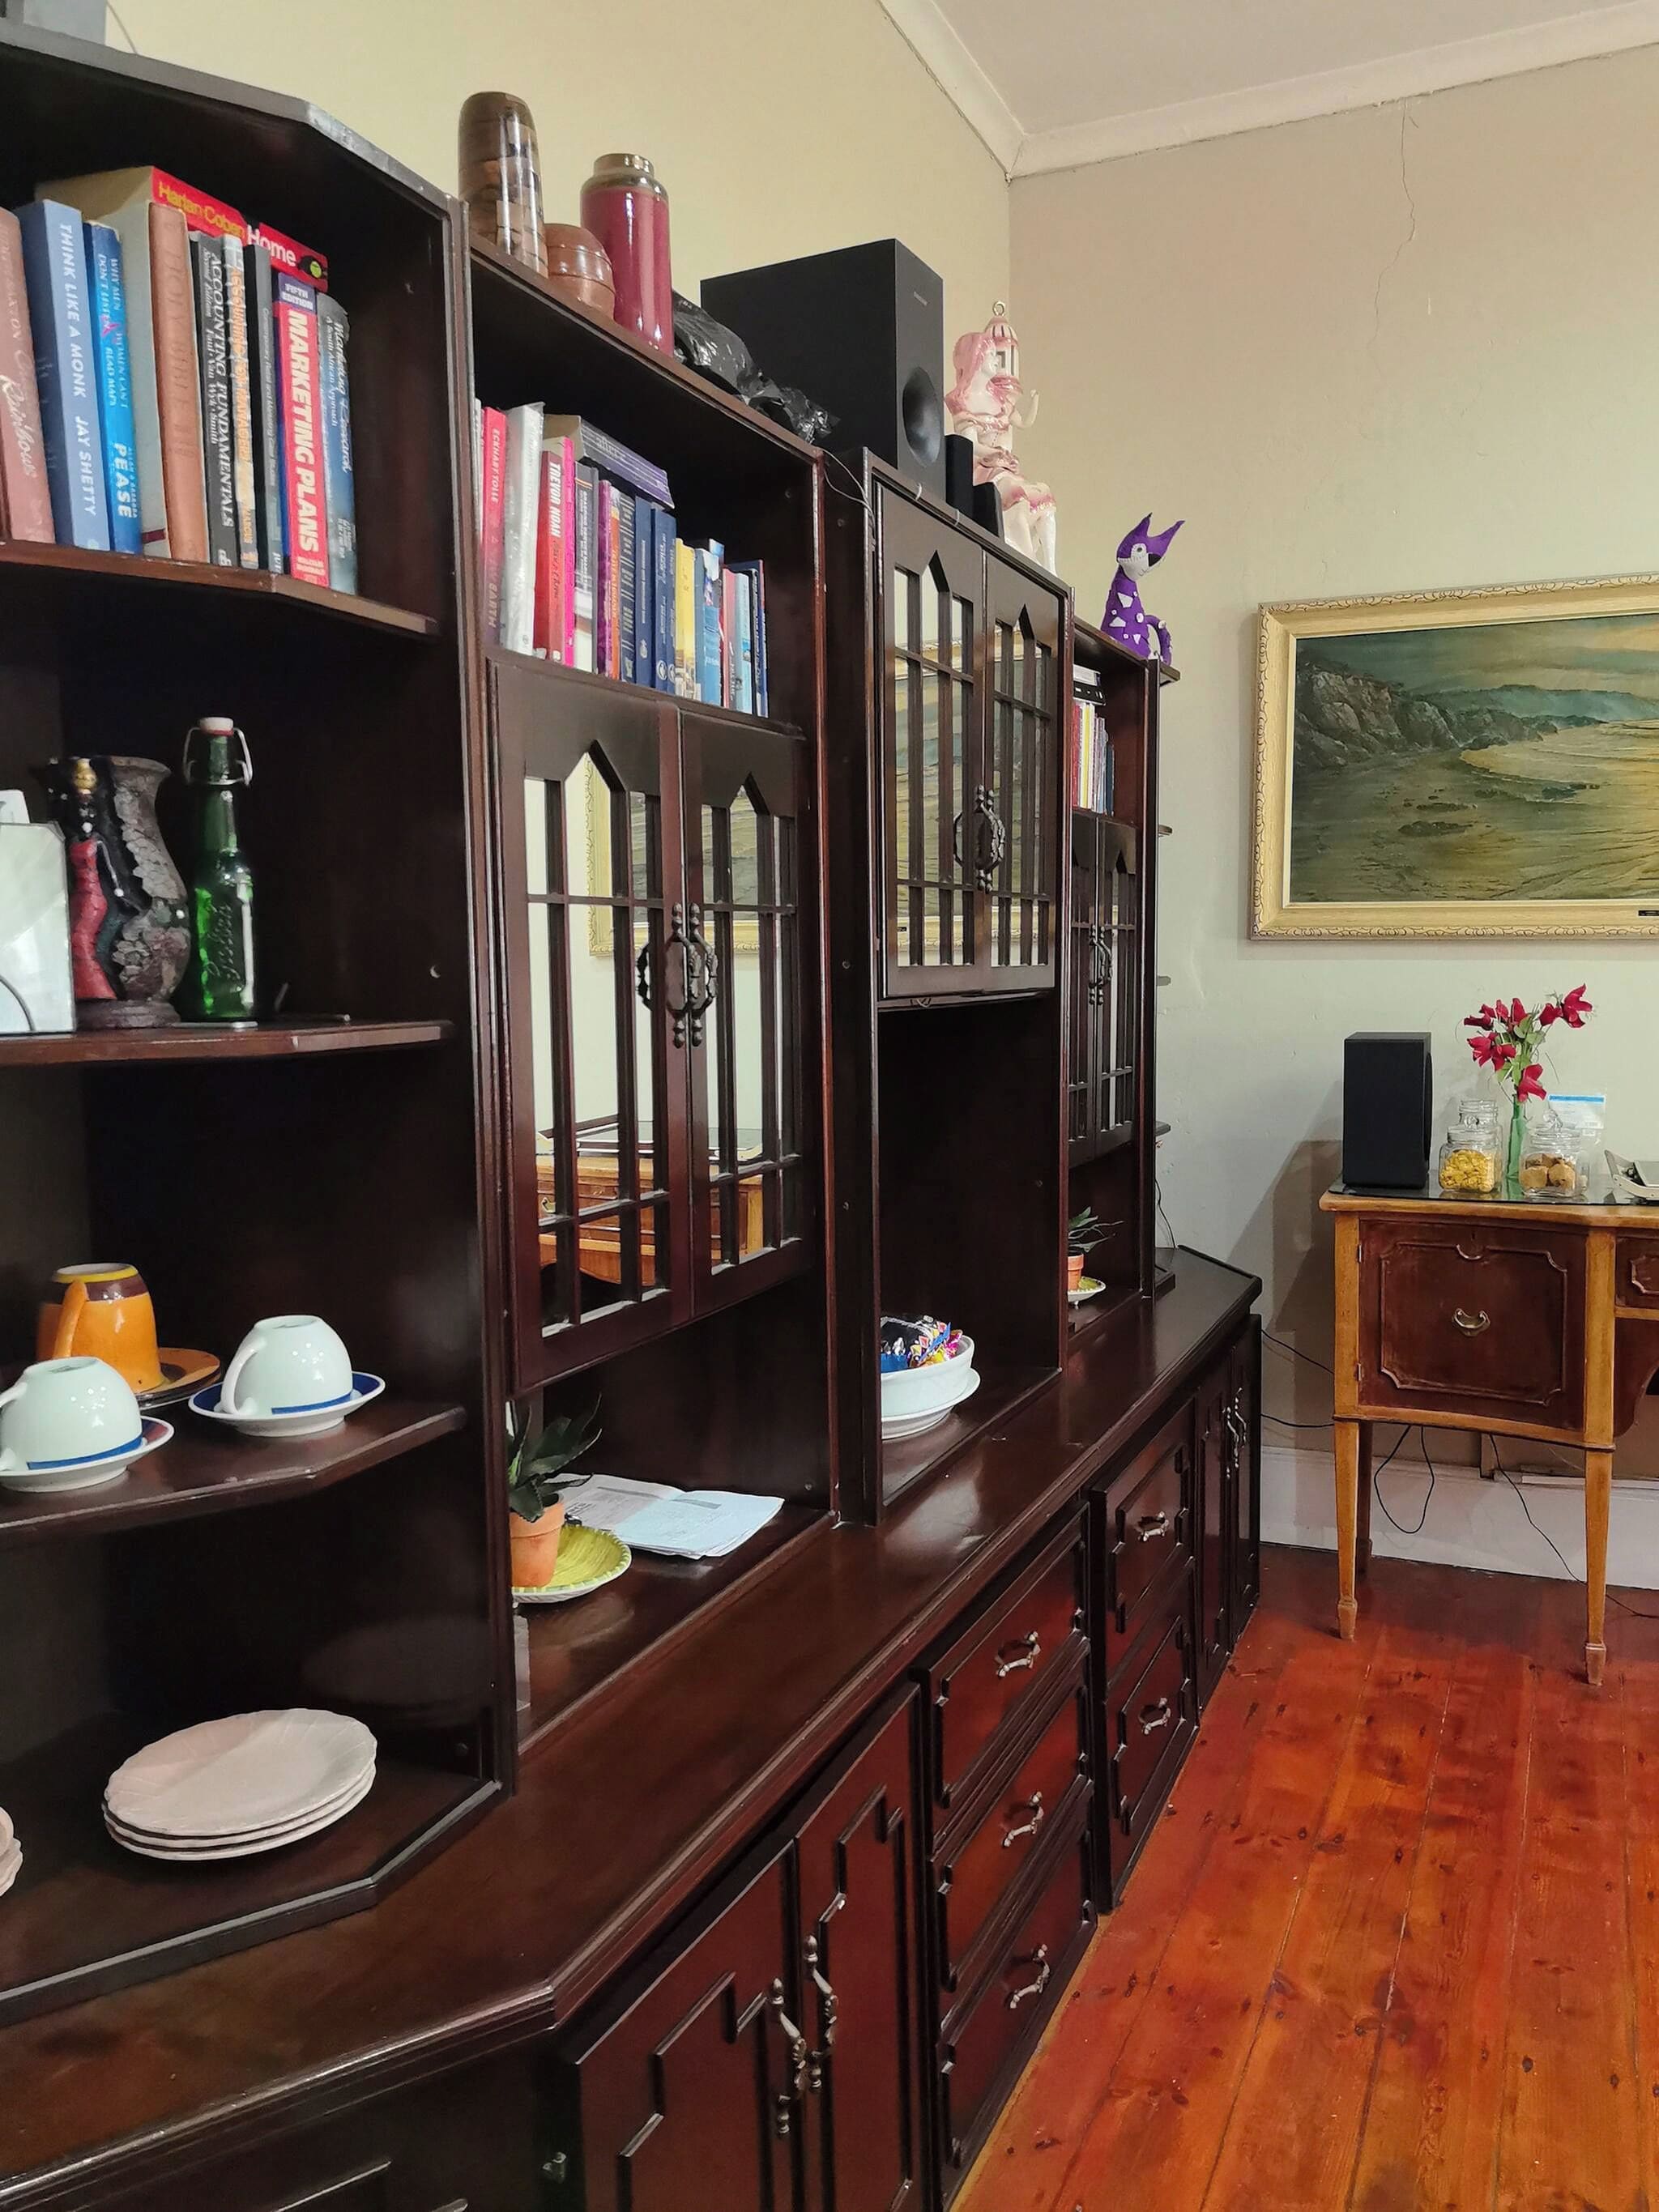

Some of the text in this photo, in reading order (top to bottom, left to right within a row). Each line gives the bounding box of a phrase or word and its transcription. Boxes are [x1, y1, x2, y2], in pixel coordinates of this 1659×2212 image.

[158, 181, 245, 239] Harlan Coben
[246, 224, 296, 267] Home
[59, 224, 87, 398] THINK LIKE A MONK
[110, 258, 122, 311] WHY MEN
[105, 347, 117, 406] READ MAPS
[211, 251, 234, 527] ACCOUNTING FUNDAMENTALS
[288, 309, 315, 467] MARKETING
[334, 322, 348, 396] Marketing
[0, 374, 38, 479] Rainbows
[210, 413, 219, 445] Smith
[75, 416, 96, 516] JAY SHETTY
[113, 442, 133, 518] PEASE
[549, 461, 561, 538] TREVOR NOAH
[295, 467, 319, 552] PLANS
